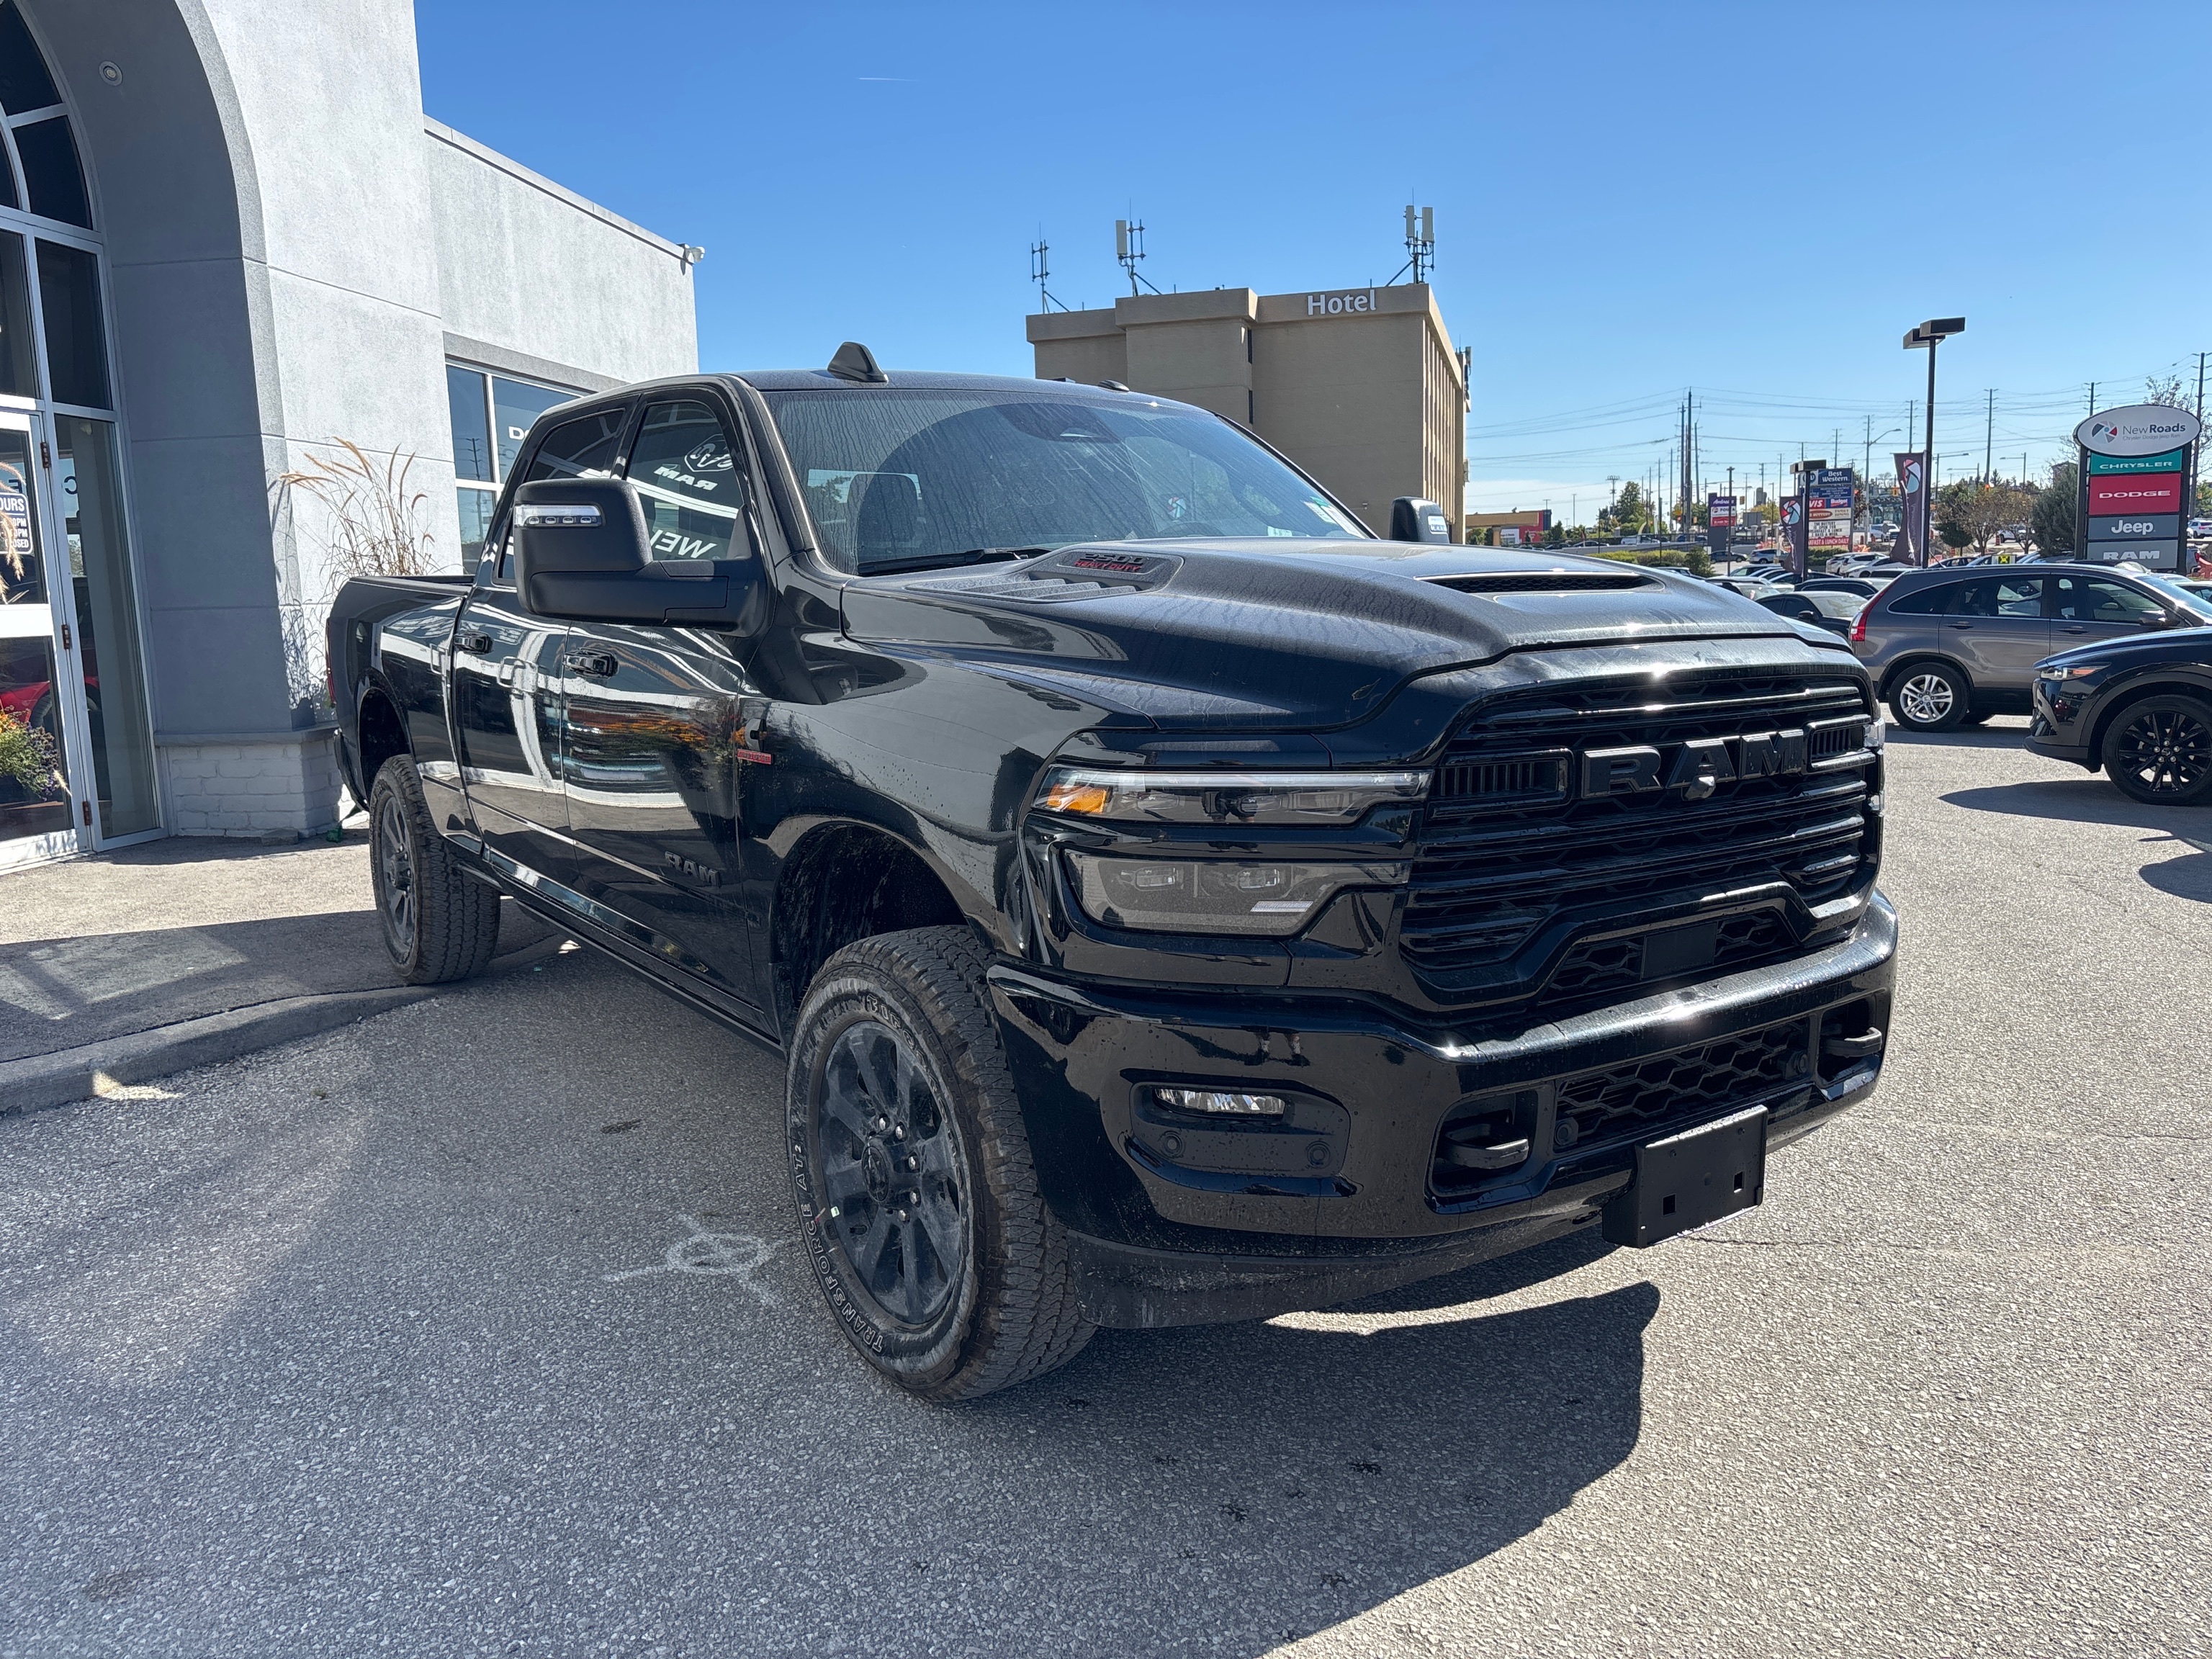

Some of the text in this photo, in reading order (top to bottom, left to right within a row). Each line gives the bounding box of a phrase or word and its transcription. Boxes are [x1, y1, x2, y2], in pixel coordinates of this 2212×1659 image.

[1307, 289, 1377, 315] Hotel
[2099, 461, 2173, 469] CHRYSLER
[0, 497, 25, 512] OURS
[2110, 519, 2154, 535] Jeep
[1080, 553, 1148, 565] 2500
[2103, 550, 2161, 560] RAM
[1074, 561, 1109, 570] HEAVY
[1581, 729, 1804, 799] RAM
[665, 850, 721, 887] RAM
[801, 1202, 884, 1353] TRANSFORCE
